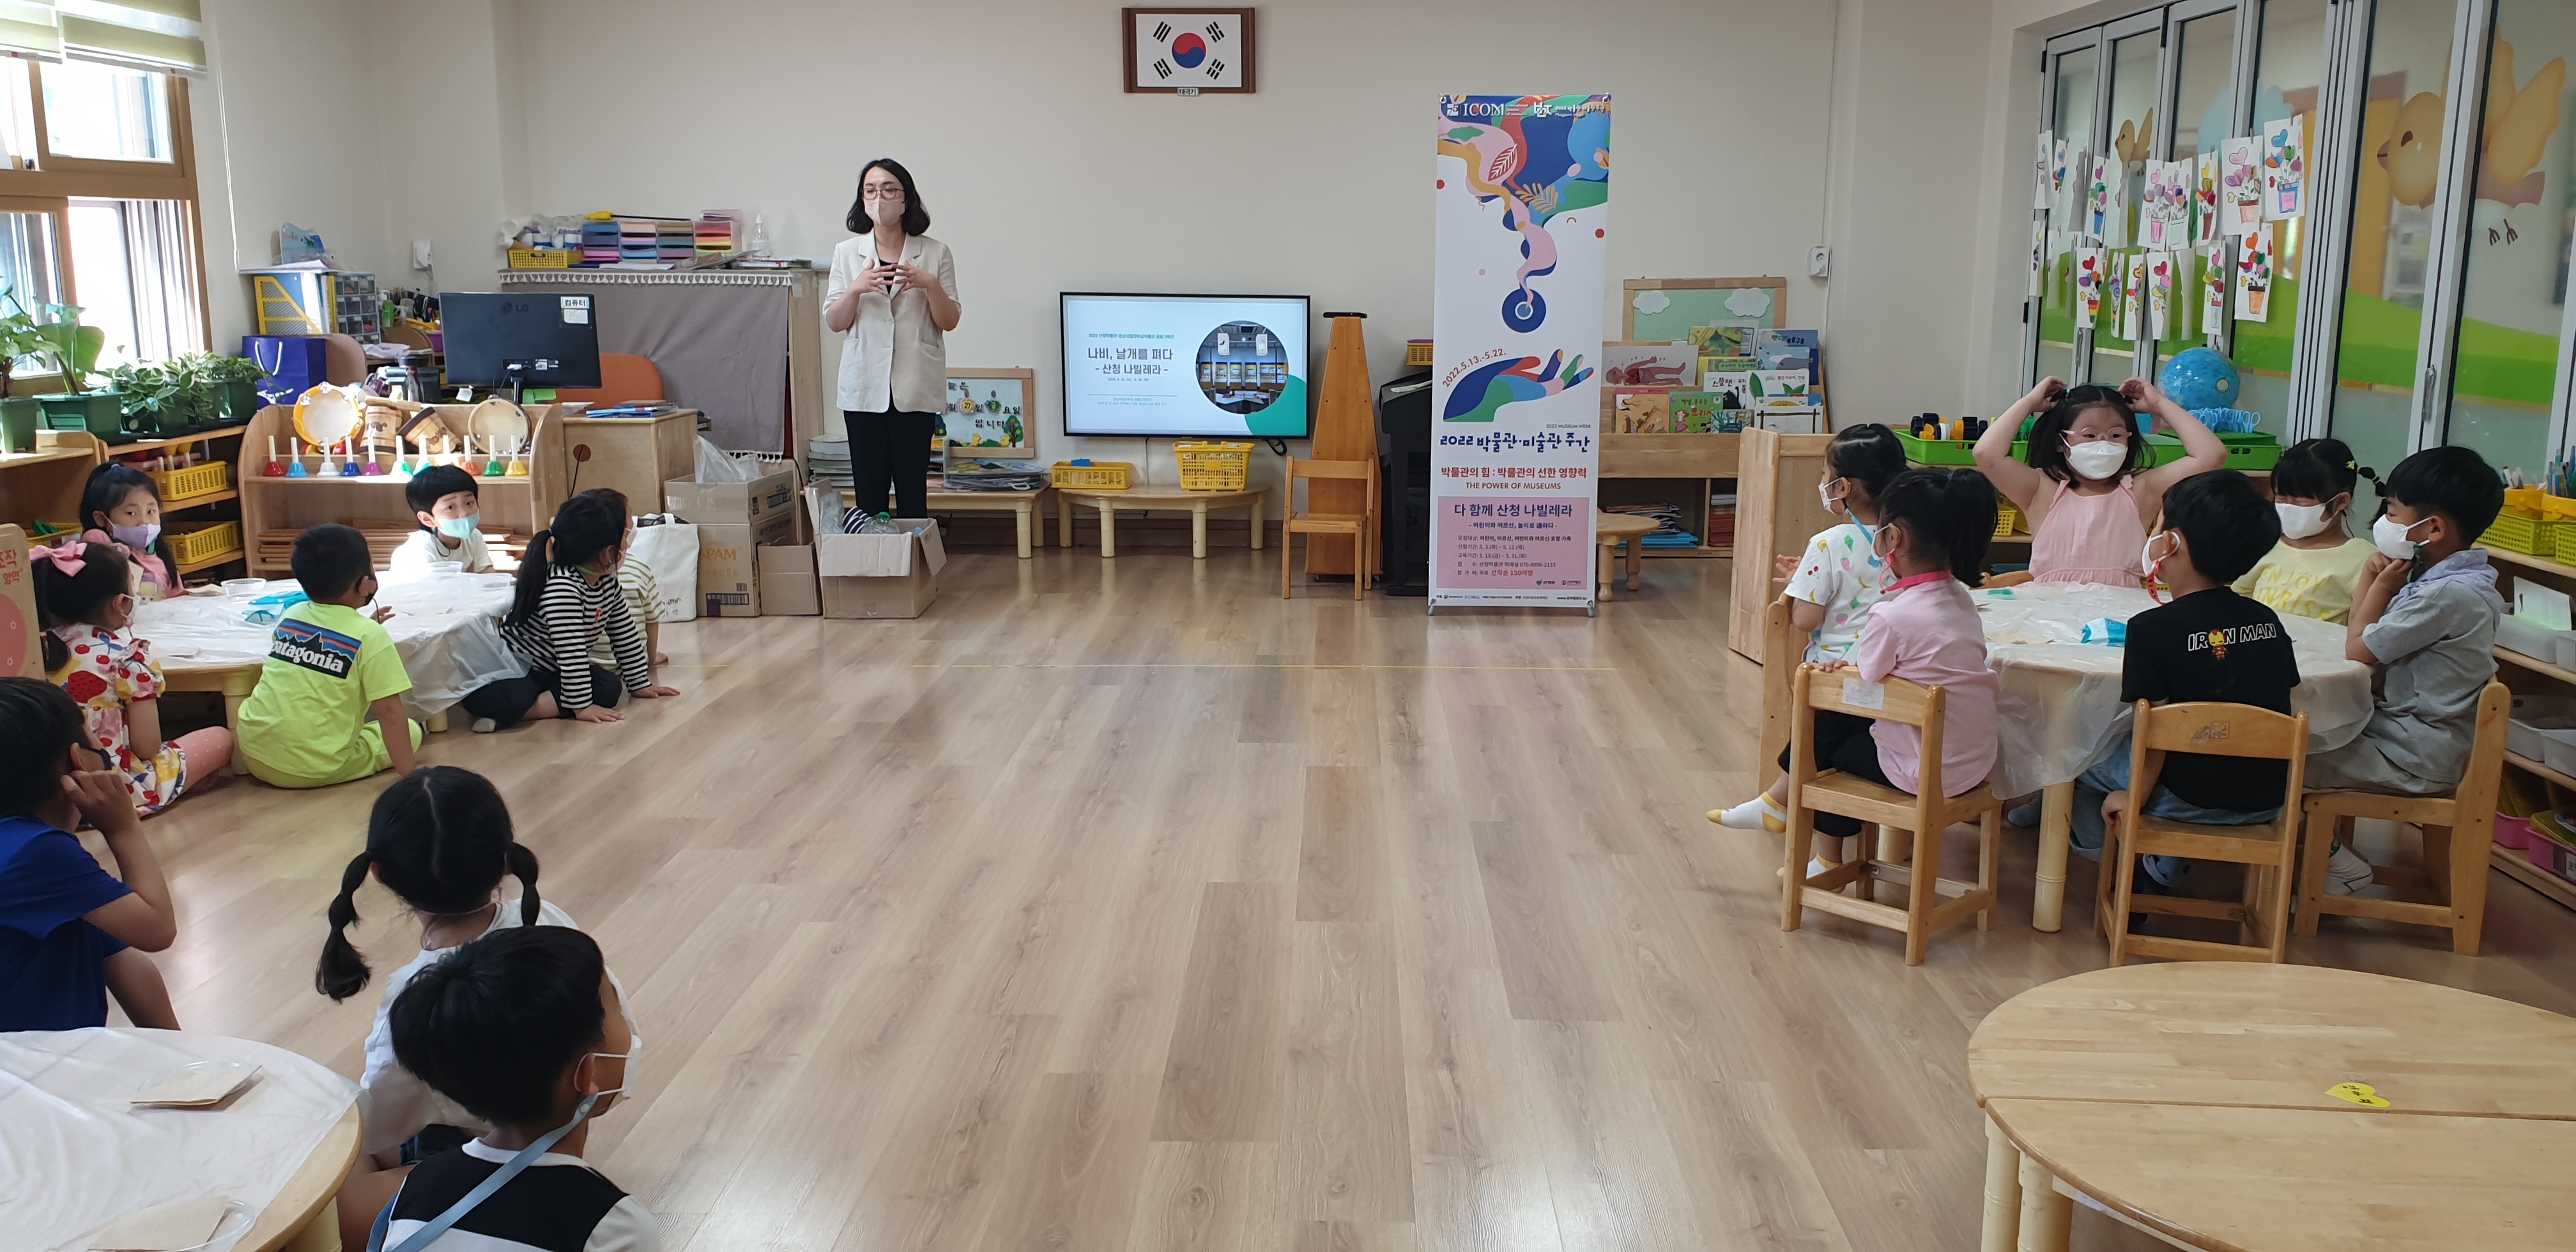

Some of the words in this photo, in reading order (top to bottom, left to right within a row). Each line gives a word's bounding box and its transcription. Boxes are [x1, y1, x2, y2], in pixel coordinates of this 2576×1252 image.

[1463, 103, 1504, 116] ICOM
[1088, 347, 1112, 360] 나비,
[1116, 348, 1147, 360] 날개를
[1152, 349, 1173, 360] 펴다
[1102, 364, 1121, 374] 산청
[1124, 364, 1162, 375] 나빌레라
[1442, 348, 1506, 388] 2022.5.13.-5.22.
[975, 419, 1005, 429] 입니다
[1440, 436, 1474, 445] 2022
[1476, 431, 1562, 453] 박물관·미술관
[1565, 432, 1590, 453] 주간
[1441, 467, 1479, 478] 박물관의
[1481, 468, 1490, 478] 힘
[1498, 468, 1535, 478] 박물관의
[1537, 468, 1556, 478] 선한
[1559, 468, 1587, 478] 영향력
[1454, 504, 1466, 516] 다
[1469, 504, 1493, 517] 함께
[1496, 504, 1521, 517] 산청
[1524, 504, 1573, 517] 나빌레라
[2240, 623, 2277, 643] MAN
